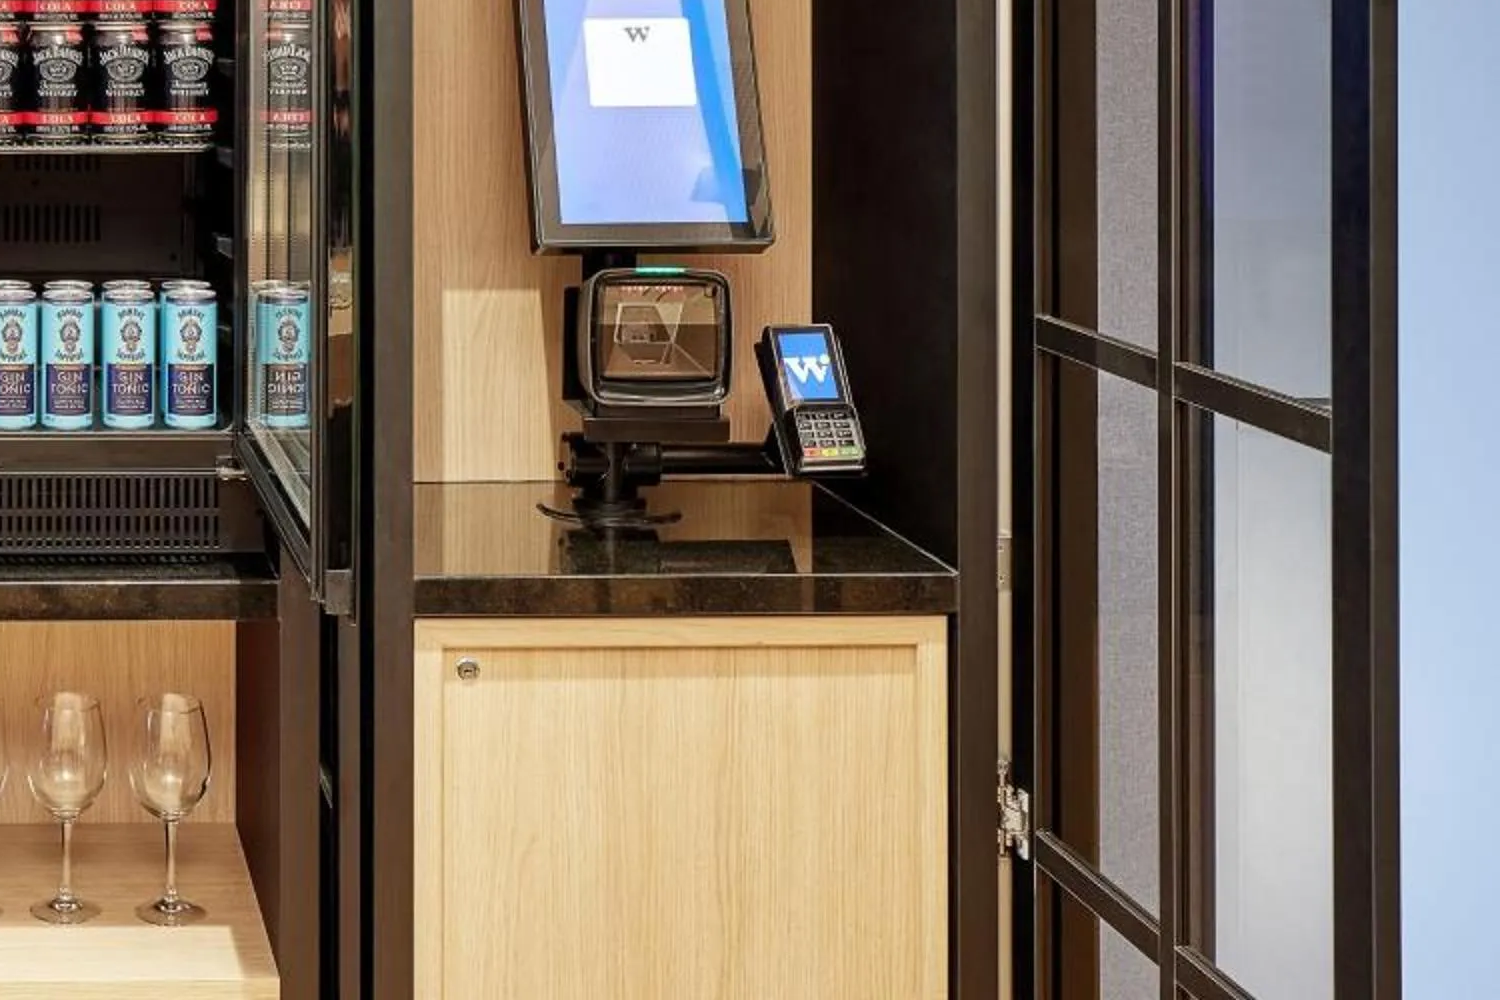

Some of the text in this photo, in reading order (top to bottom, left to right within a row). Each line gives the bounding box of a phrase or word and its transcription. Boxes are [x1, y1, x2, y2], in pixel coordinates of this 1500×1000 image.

[0, 372, 25, 382] GIN
[57, 372, 83, 382] GIN
[119, 372, 143, 382] GIN
[179, 372, 204, 382] GIN
[51, 384, 88, 394] TONIC
[112, 384, 149, 394] TONIC
[172, 384, 211, 394] TONIC
